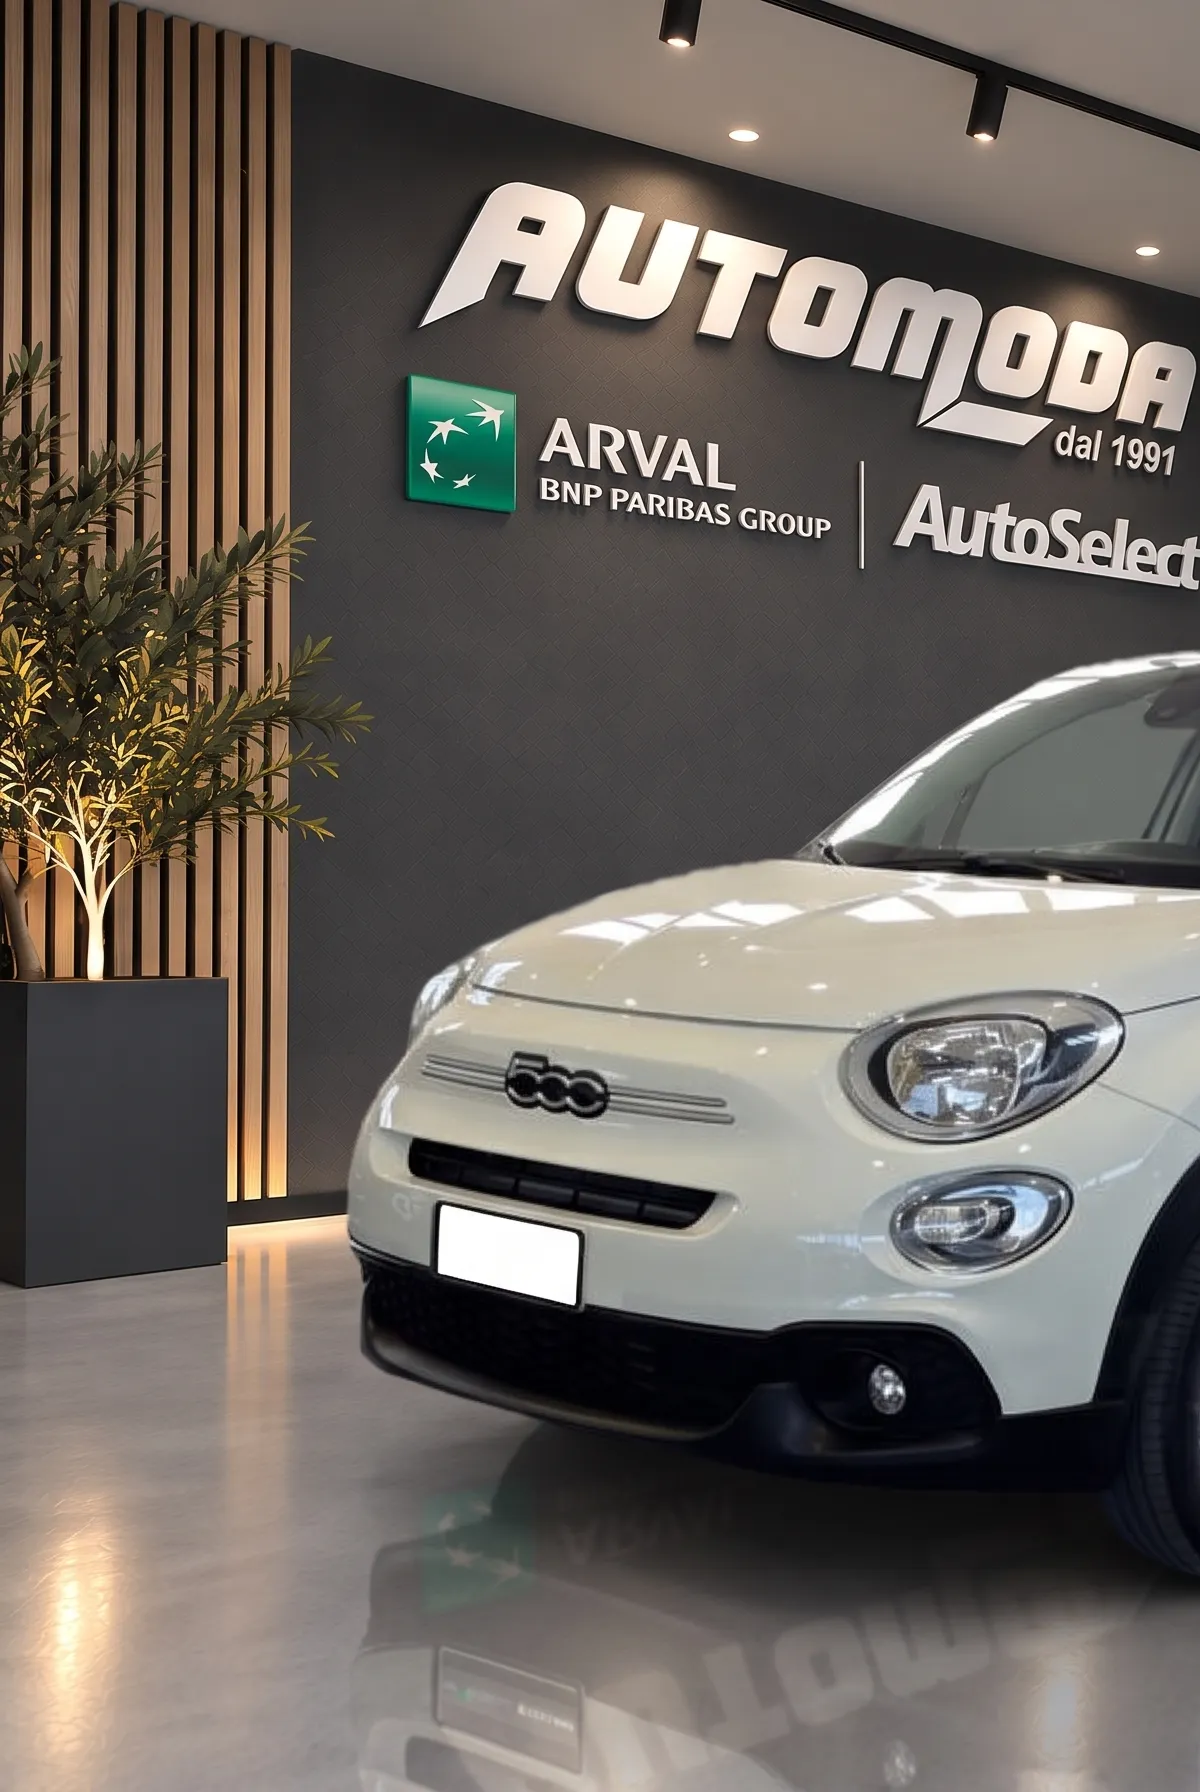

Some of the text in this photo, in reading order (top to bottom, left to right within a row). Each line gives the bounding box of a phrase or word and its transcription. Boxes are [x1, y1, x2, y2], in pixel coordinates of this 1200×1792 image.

[418, 182, 1198, 446] AUTOMODA
[538, 417, 737, 491] ARVAL
[1054, 425, 1176, 475] dal 1991
[539, 477, 832, 539] BNP PARIBAS GROUP
[505, 1051, 610, 1119] 500
